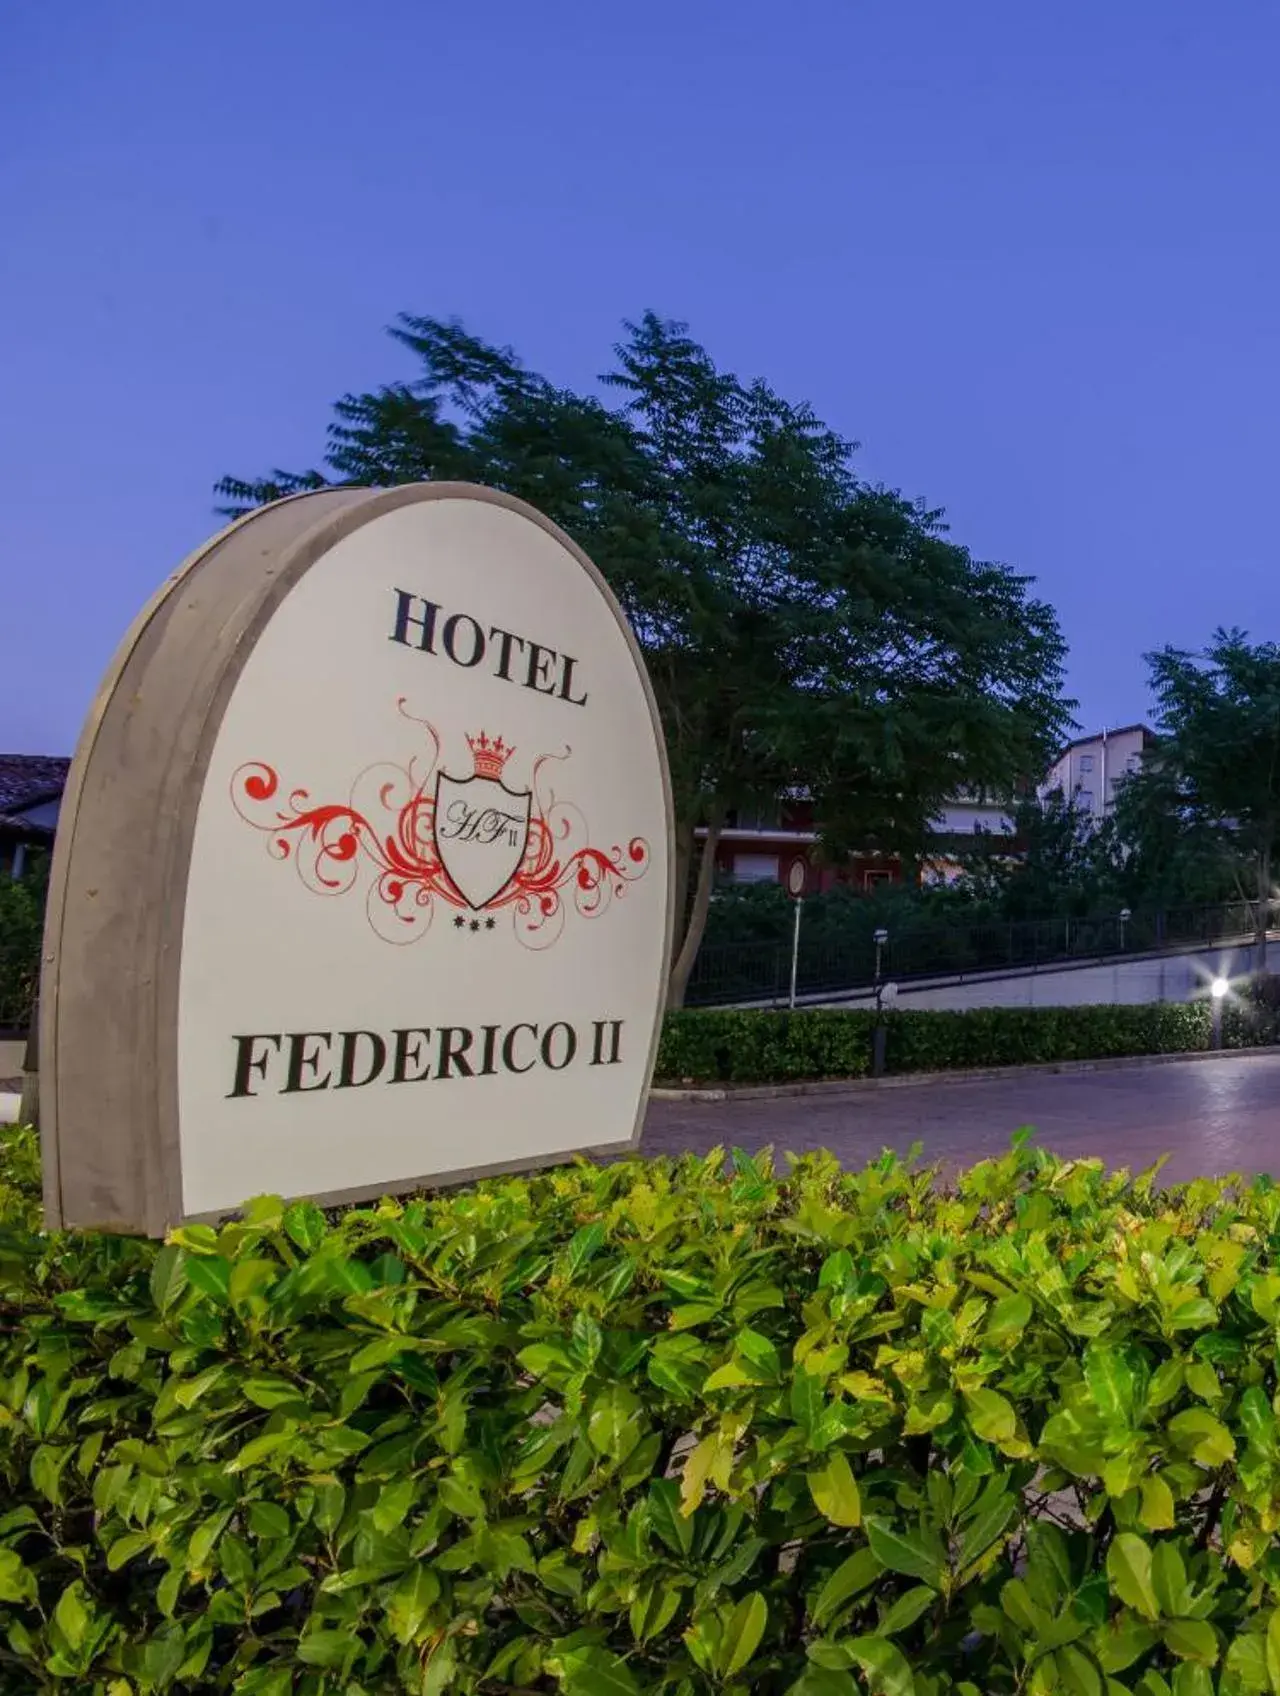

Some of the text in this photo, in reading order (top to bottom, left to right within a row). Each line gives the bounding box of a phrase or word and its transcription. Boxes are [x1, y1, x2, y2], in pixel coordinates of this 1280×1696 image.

[388, 587, 589, 706] HOTEL
[224, 1019, 625, 1099] FEDERICO II
